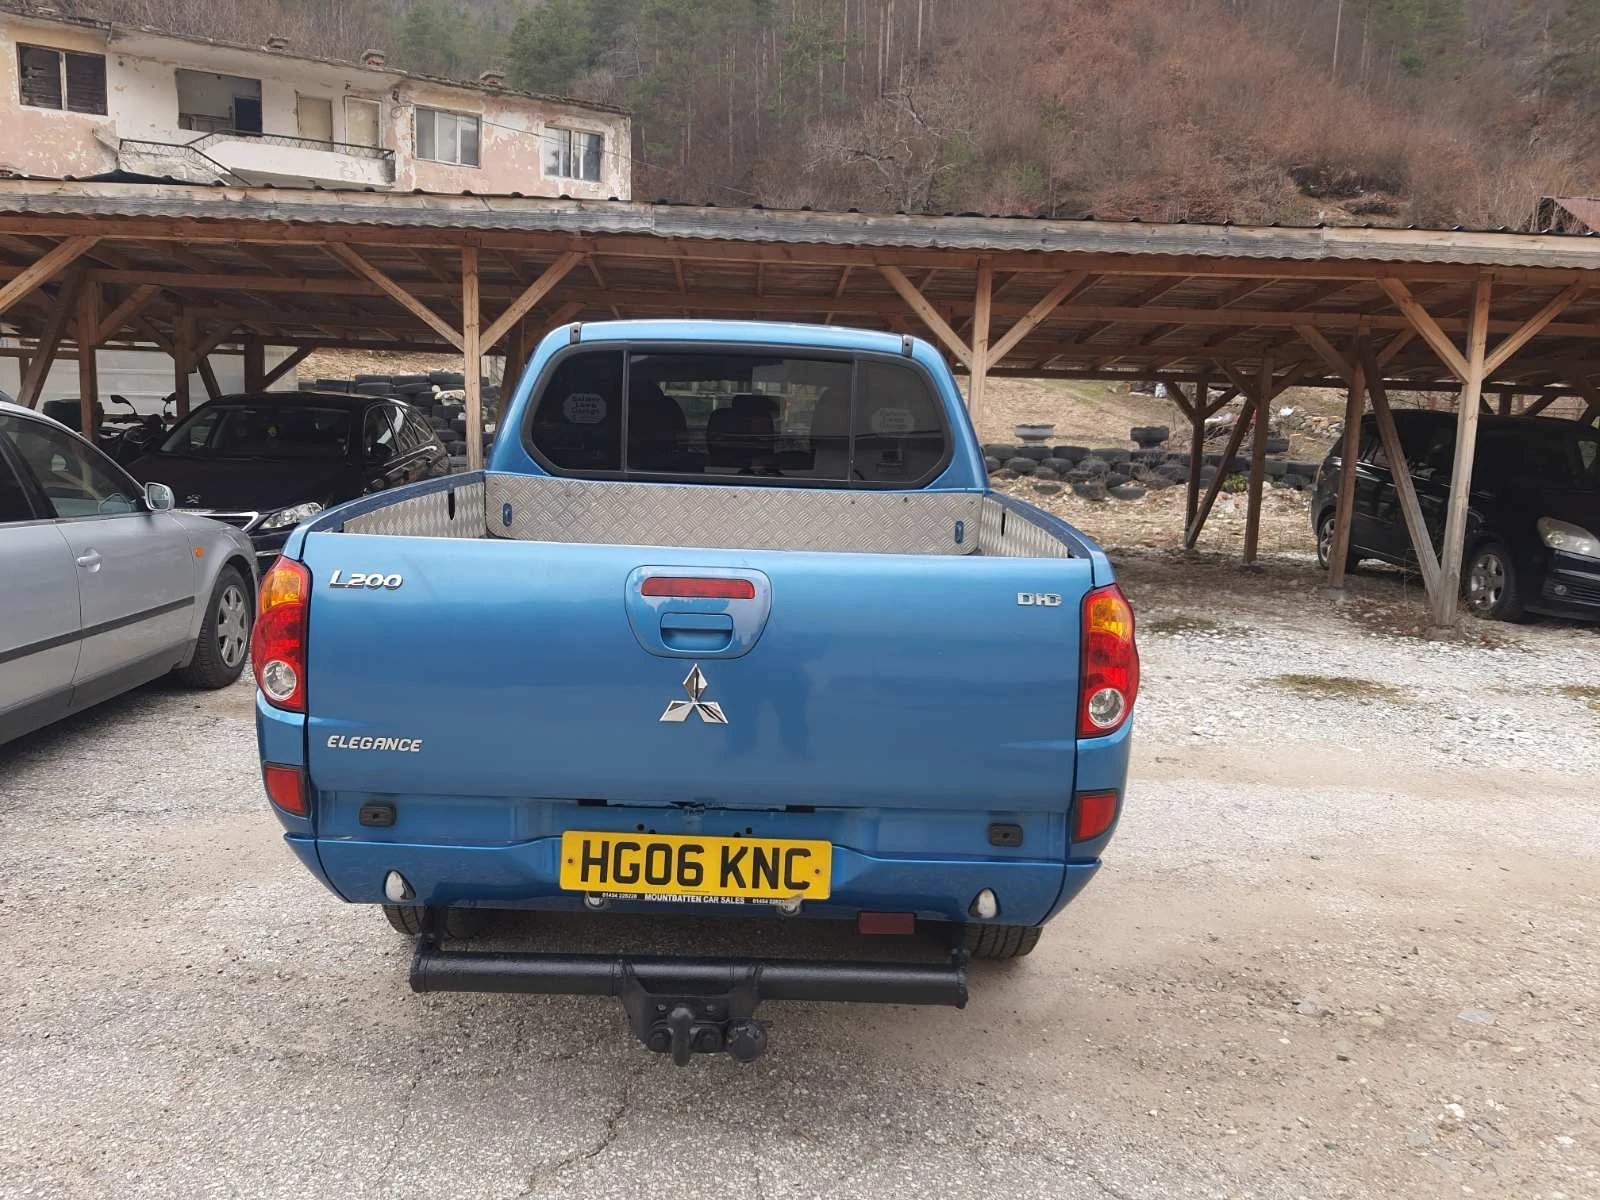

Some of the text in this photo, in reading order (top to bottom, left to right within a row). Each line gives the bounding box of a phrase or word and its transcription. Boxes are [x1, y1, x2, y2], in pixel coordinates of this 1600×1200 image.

[329, 570, 403, 590] L200
[327, 735, 423, 752] ELEGANCE
[580, 840, 812, 891] HG06 KNC
[644, 893, 702, 904] MOUNTBATTEN
[703, 895, 719, 904] CAR
[720, 896, 745, 905] SALES
